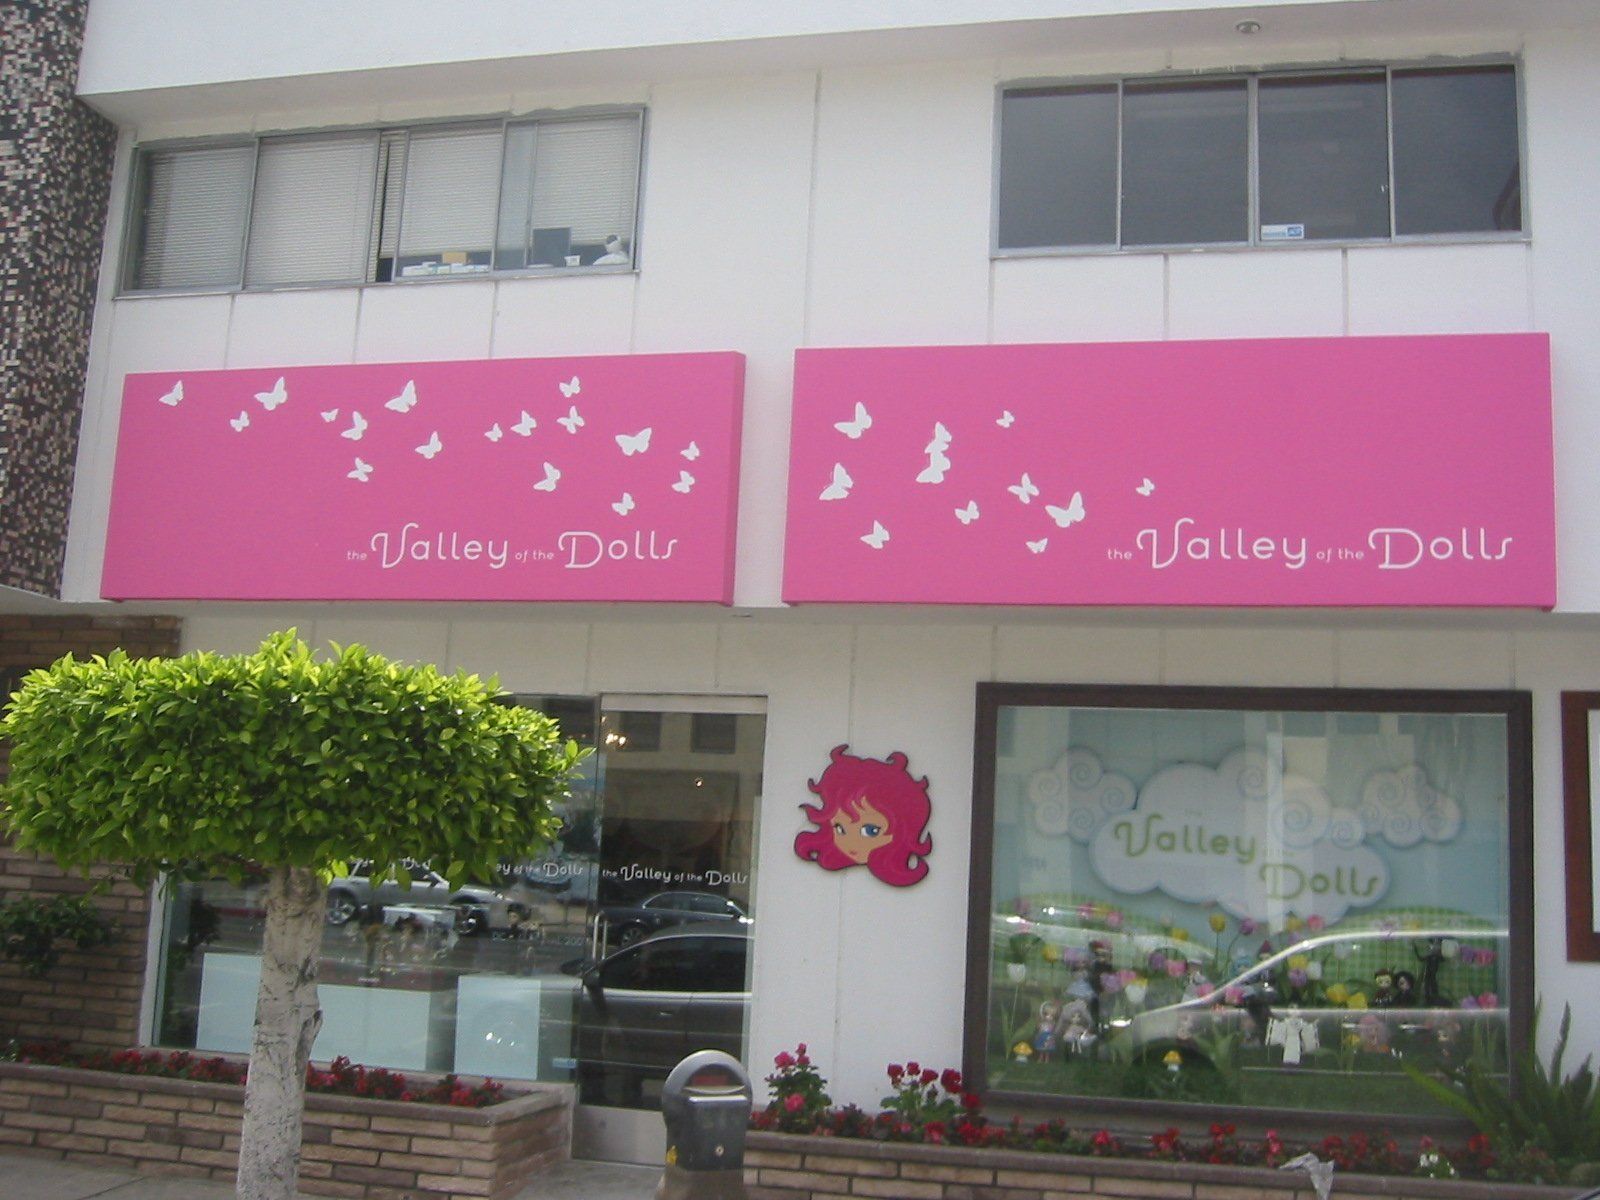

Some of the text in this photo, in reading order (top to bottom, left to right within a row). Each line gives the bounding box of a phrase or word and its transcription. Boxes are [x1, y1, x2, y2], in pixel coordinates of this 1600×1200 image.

[346, 522, 678, 569] the Valley of the Dolls
[1107, 516, 1513, 570] the Valley of the Dolls
[1114, 813, 1256, 865] Valley
[542, 862, 585, 877] Dolls
[602, 868, 618, 877] the
[620, 863, 672, 883] Valley
[687, 872, 703, 882] the
[705, 869, 749, 886] Dolls
[1259, 862, 1379, 900] Dolls
